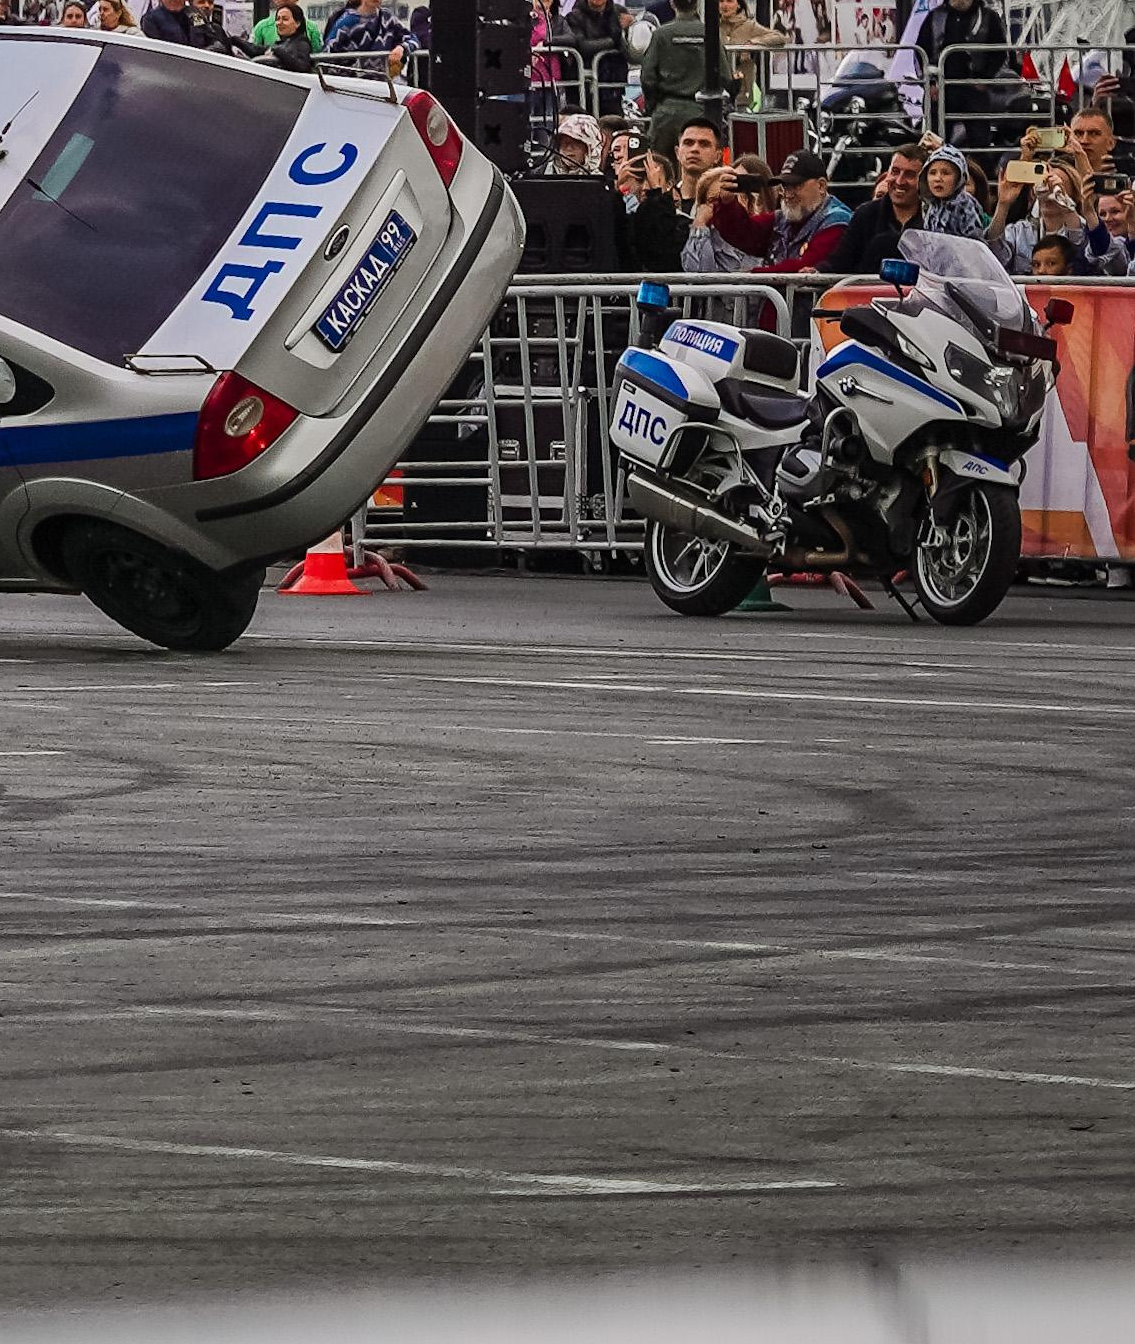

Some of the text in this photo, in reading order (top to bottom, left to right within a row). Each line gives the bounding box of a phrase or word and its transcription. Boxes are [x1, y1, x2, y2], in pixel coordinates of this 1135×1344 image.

[200, 142, 359, 321] ДПС
[380, 220, 401, 249] 99
[325, 253, 390, 335] КАСКАД
[670, 325, 724, 354] ПОЛИЦИЯ
[618, 399, 667, 445] ДПС
[961, 460, 989, 475] ДПС
